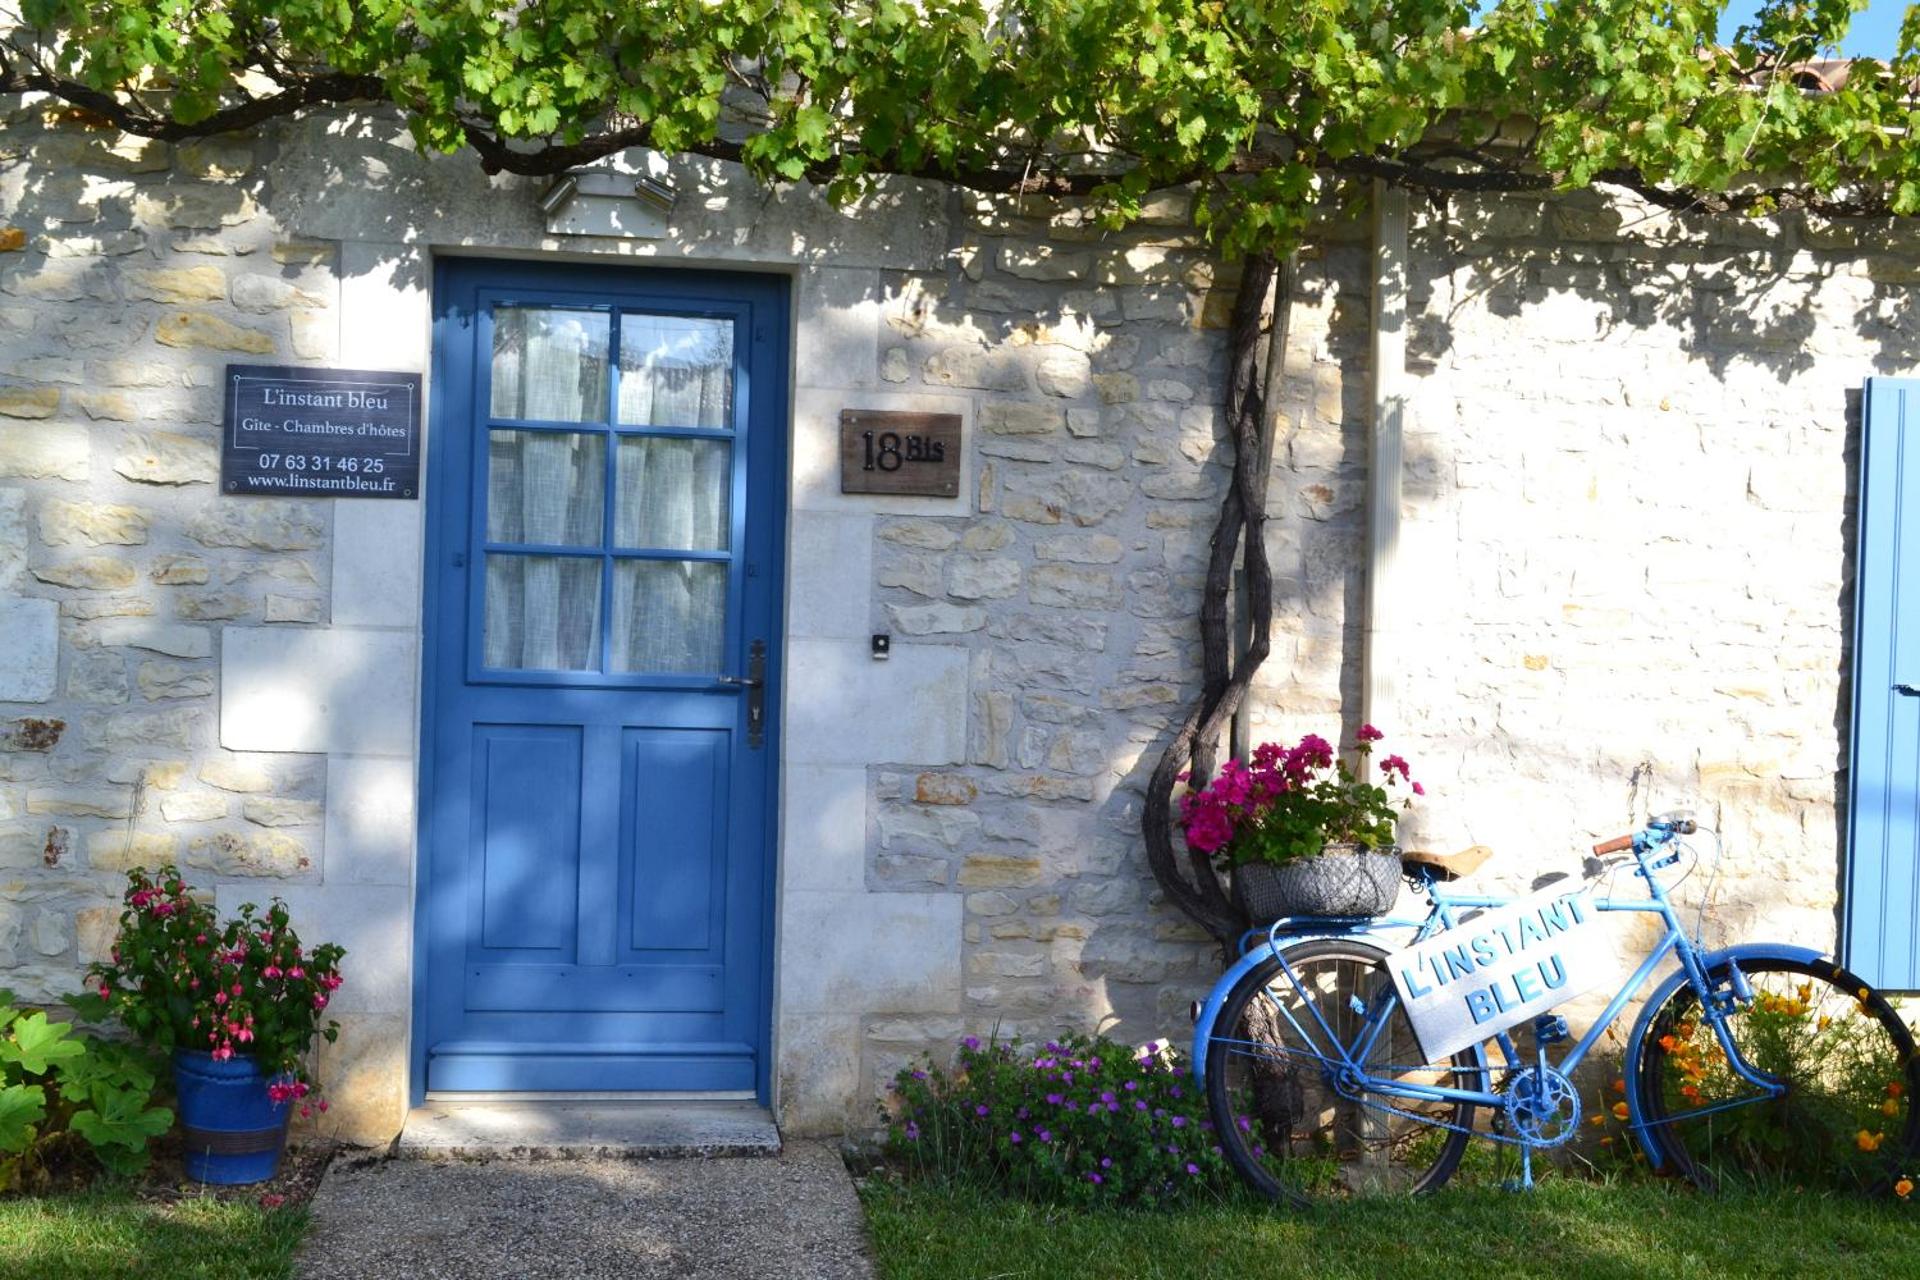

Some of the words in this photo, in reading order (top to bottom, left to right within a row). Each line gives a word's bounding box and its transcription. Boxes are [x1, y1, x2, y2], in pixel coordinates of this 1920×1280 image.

[264, 388, 342, 408] L'instant
[348, 391, 388, 410] bleu
[242, 417, 271, 431] Gîte
[283, 419, 354, 435] Chambres
[357, 422, 406, 437] d'hôtes
[862, 430, 903, 472] 18
[259, 453, 280, 469] 07
[285, 455, 306, 470] 63
[311, 456, 330, 470] 31
[337, 457, 358, 472] 46
[363, 458, 384, 473] 25
[248, 473, 396, 491] www.linstantbleu.fr
[1401, 895, 1585, 1000] L'INSTANT
[1464, 952, 1568, 1025] BLEU
